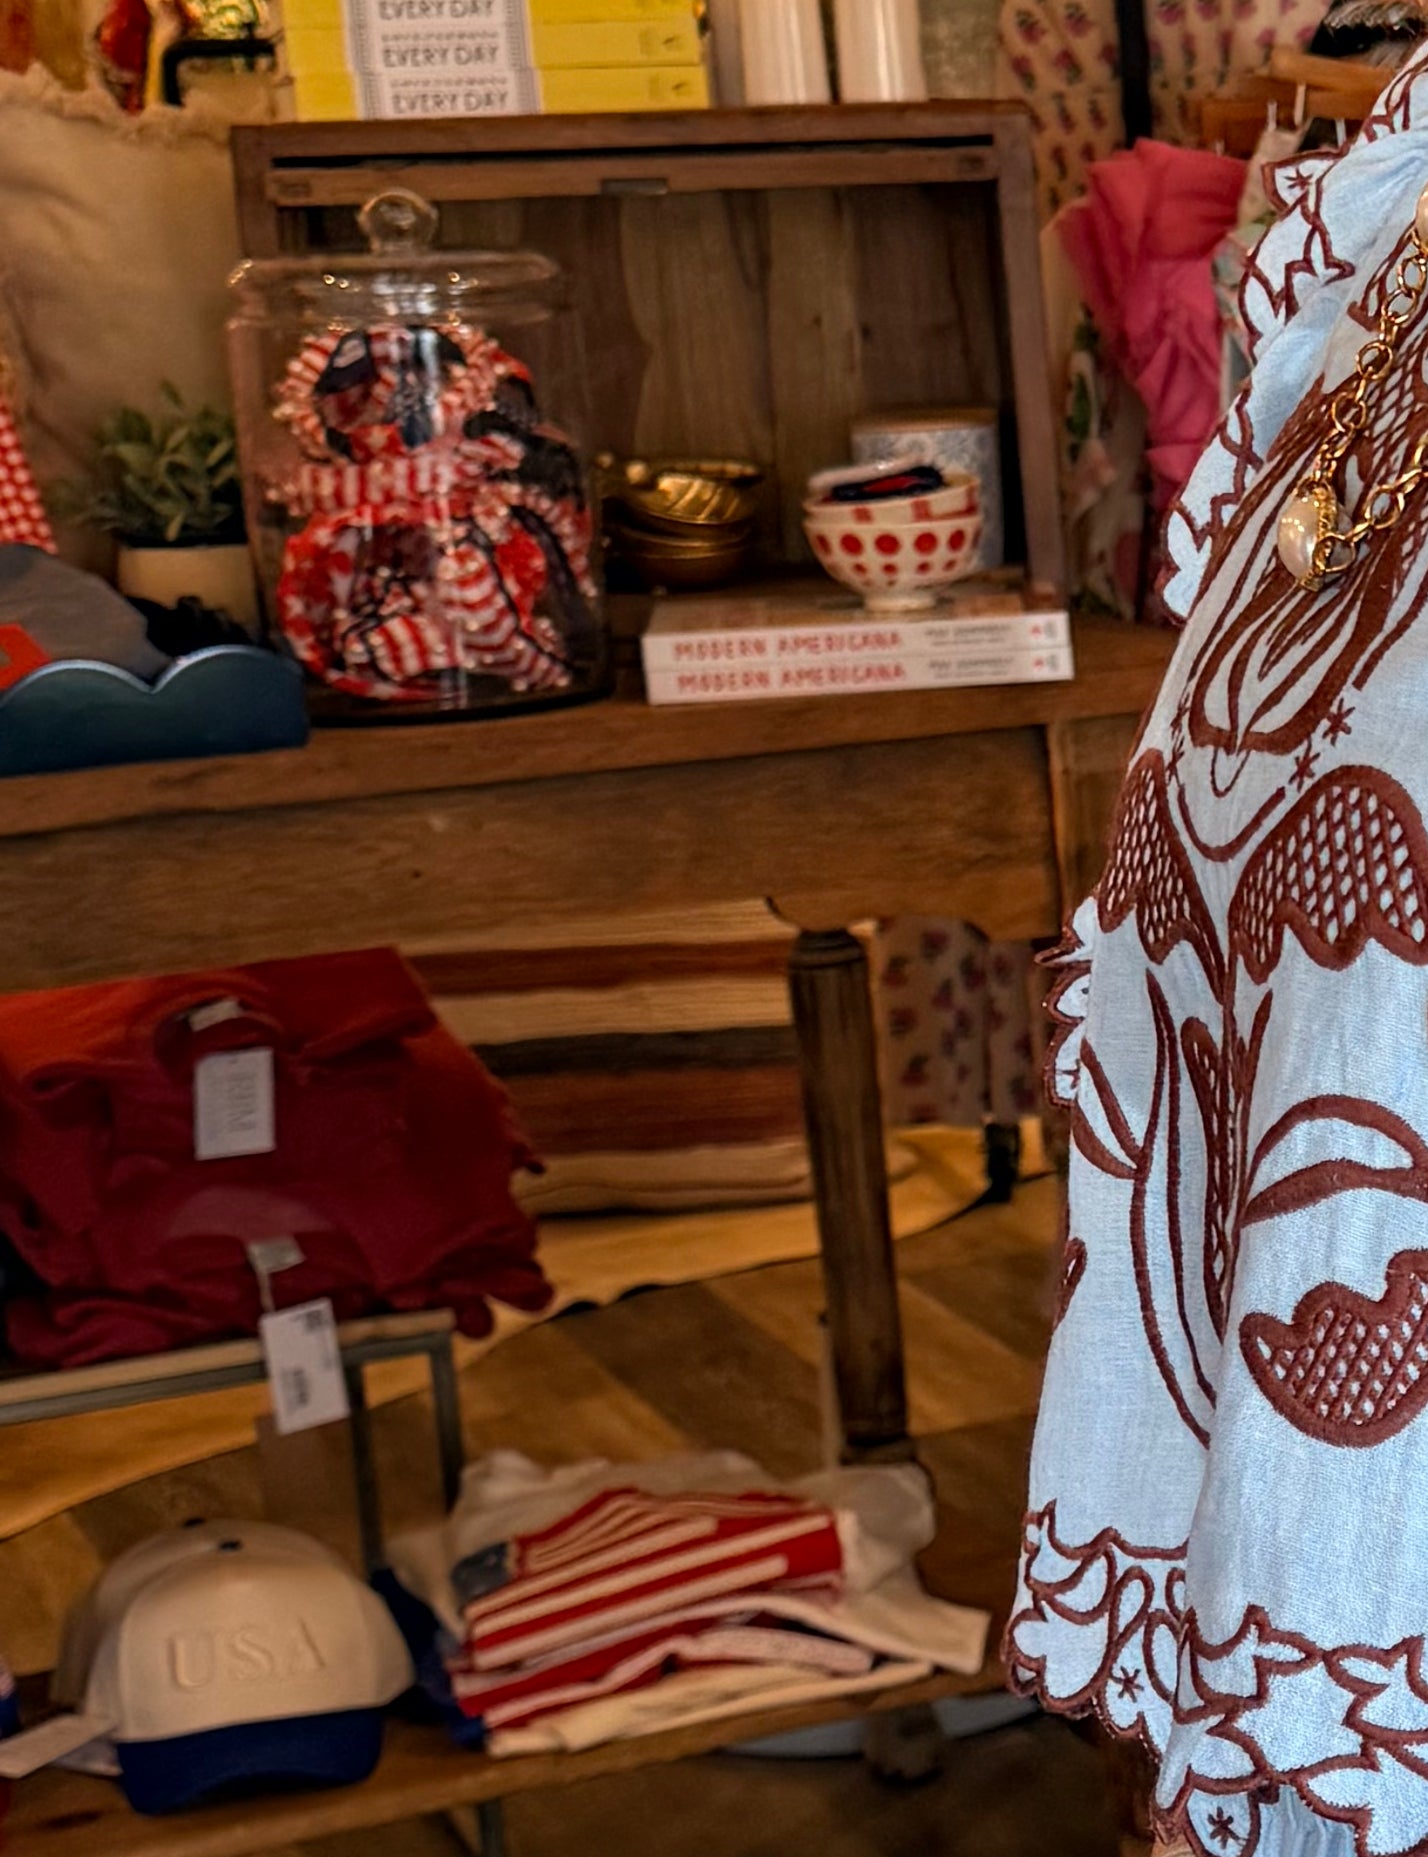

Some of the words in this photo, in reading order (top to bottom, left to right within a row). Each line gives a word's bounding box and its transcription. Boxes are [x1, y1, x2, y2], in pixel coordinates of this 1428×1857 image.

[378, 0, 445, 20] EVERY
[383, 47, 449, 68] EVERY
[454, 46, 499, 66] DAY
[392, 93, 459, 115] EVERY
[463, 91, 509, 112] DAY
[674, 638, 767, 661] MODERN
[777, 631, 903, 656] AMERICANA
[677, 671, 771, 694] MODERN
[780, 663, 907, 687] AMERICANA
[166, 1616, 327, 1690] USA
